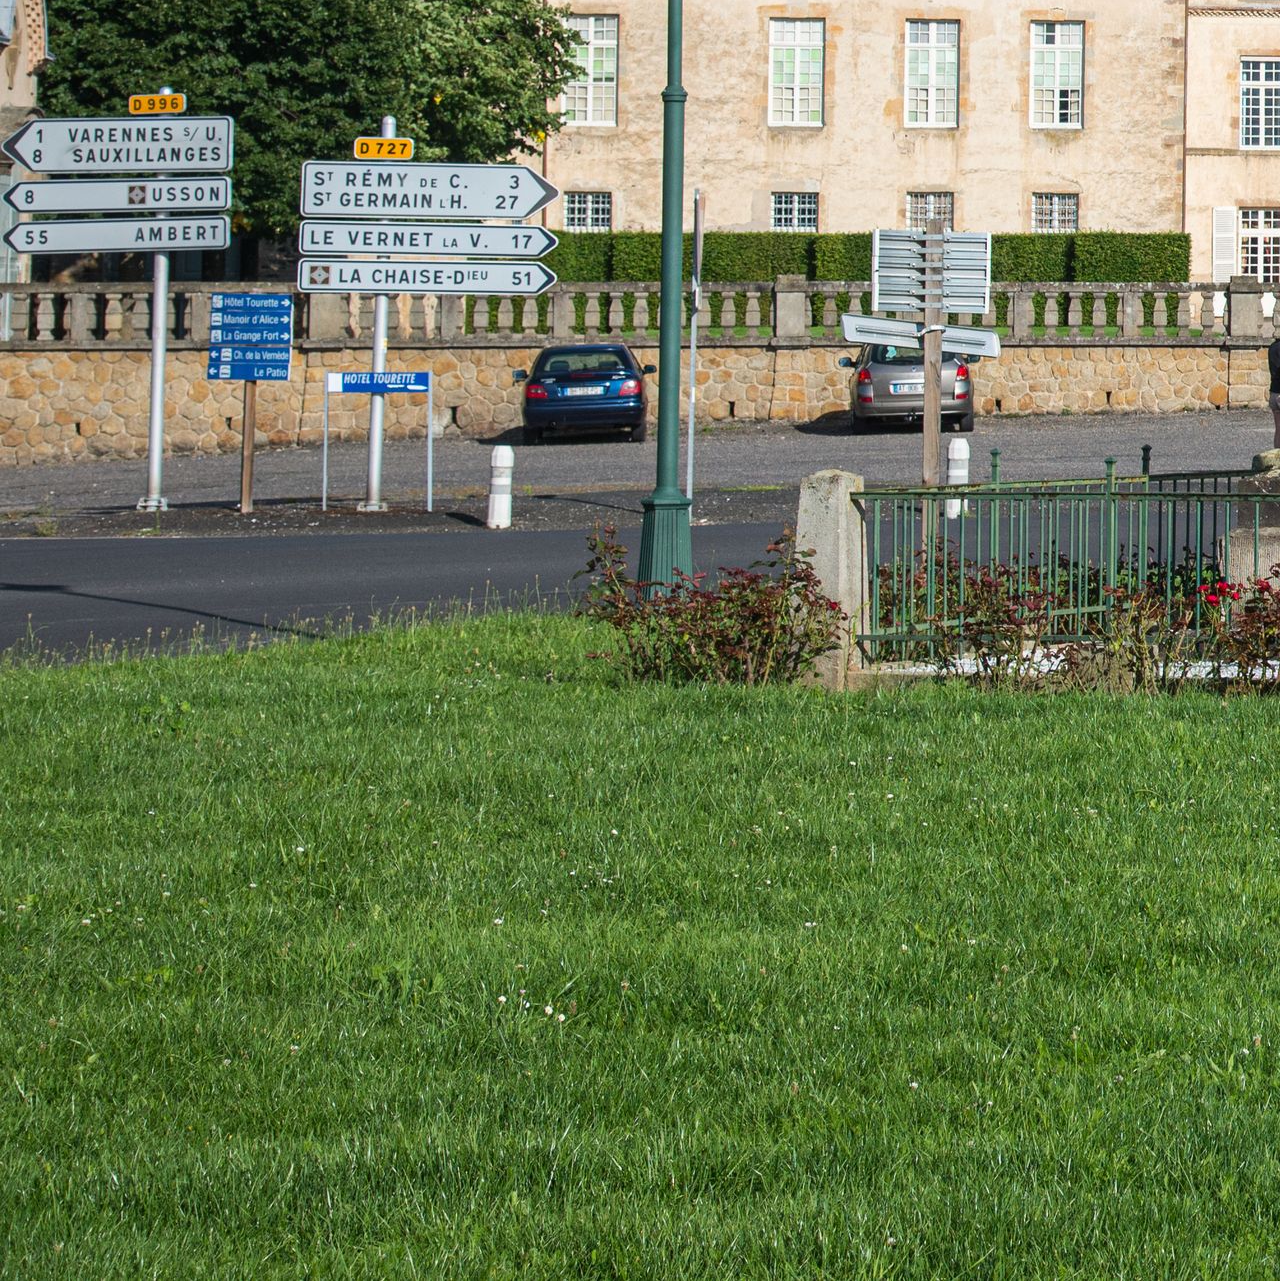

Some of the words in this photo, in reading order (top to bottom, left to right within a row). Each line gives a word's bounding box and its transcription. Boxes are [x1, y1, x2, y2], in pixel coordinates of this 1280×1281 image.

[134, 99, 141, 110] D
[147, 98, 179, 109] 996
[36, 129, 43, 143] 1
[68, 128, 173, 142] VARENNES
[206, 126, 222, 141] U.
[32, 149, 42, 164] 8
[73, 146, 221, 163] SAUXILLANGES
[360, 143, 369, 154] D
[376, 143, 408, 154] 727
[346, 169, 408, 187] RÉMY
[420, 178, 437, 188] DE
[450, 174, 468, 189] C.
[510, 175, 520, 189] 3
[25, 190, 34, 204] 8
[152, 187, 220, 202] USSON
[340, 192, 432, 208] GERMAIN
[495, 195, 519, 210] 27
[25, 230, 48, 245] 55
[135, 226, 219, 242] AMBERT
[310, 230, 334, 245] LE
[348, 231, 433, 247] VERNET
[443, 238, 458, 247] LA
[470, 234, 488, 248] V.
[511, 235, 533, 249] 17
[339, 268, 362, 283] LA
[372, 269, 488, 285] CHAISE-DIEU
[512, 272, 532, 286] 51
[224, 297, 244, 307] Hôtel
[246, 298, 278, 307] Tourette
[223, 314, 250, 324] Manoir
[252, 314, 278, 324] d'Alice
[223, 331, 232, 340] La
[234, 331, 261, 342] Grange
[263, 331, 279, 340] Fort
[245, 350, 253, 359] de
[255, 351, 261, 359] la
[254, 368, 264, 377] Le
[266, 368, 287, 377] Patio
[373, 374, 416, 384] TOURETTE
